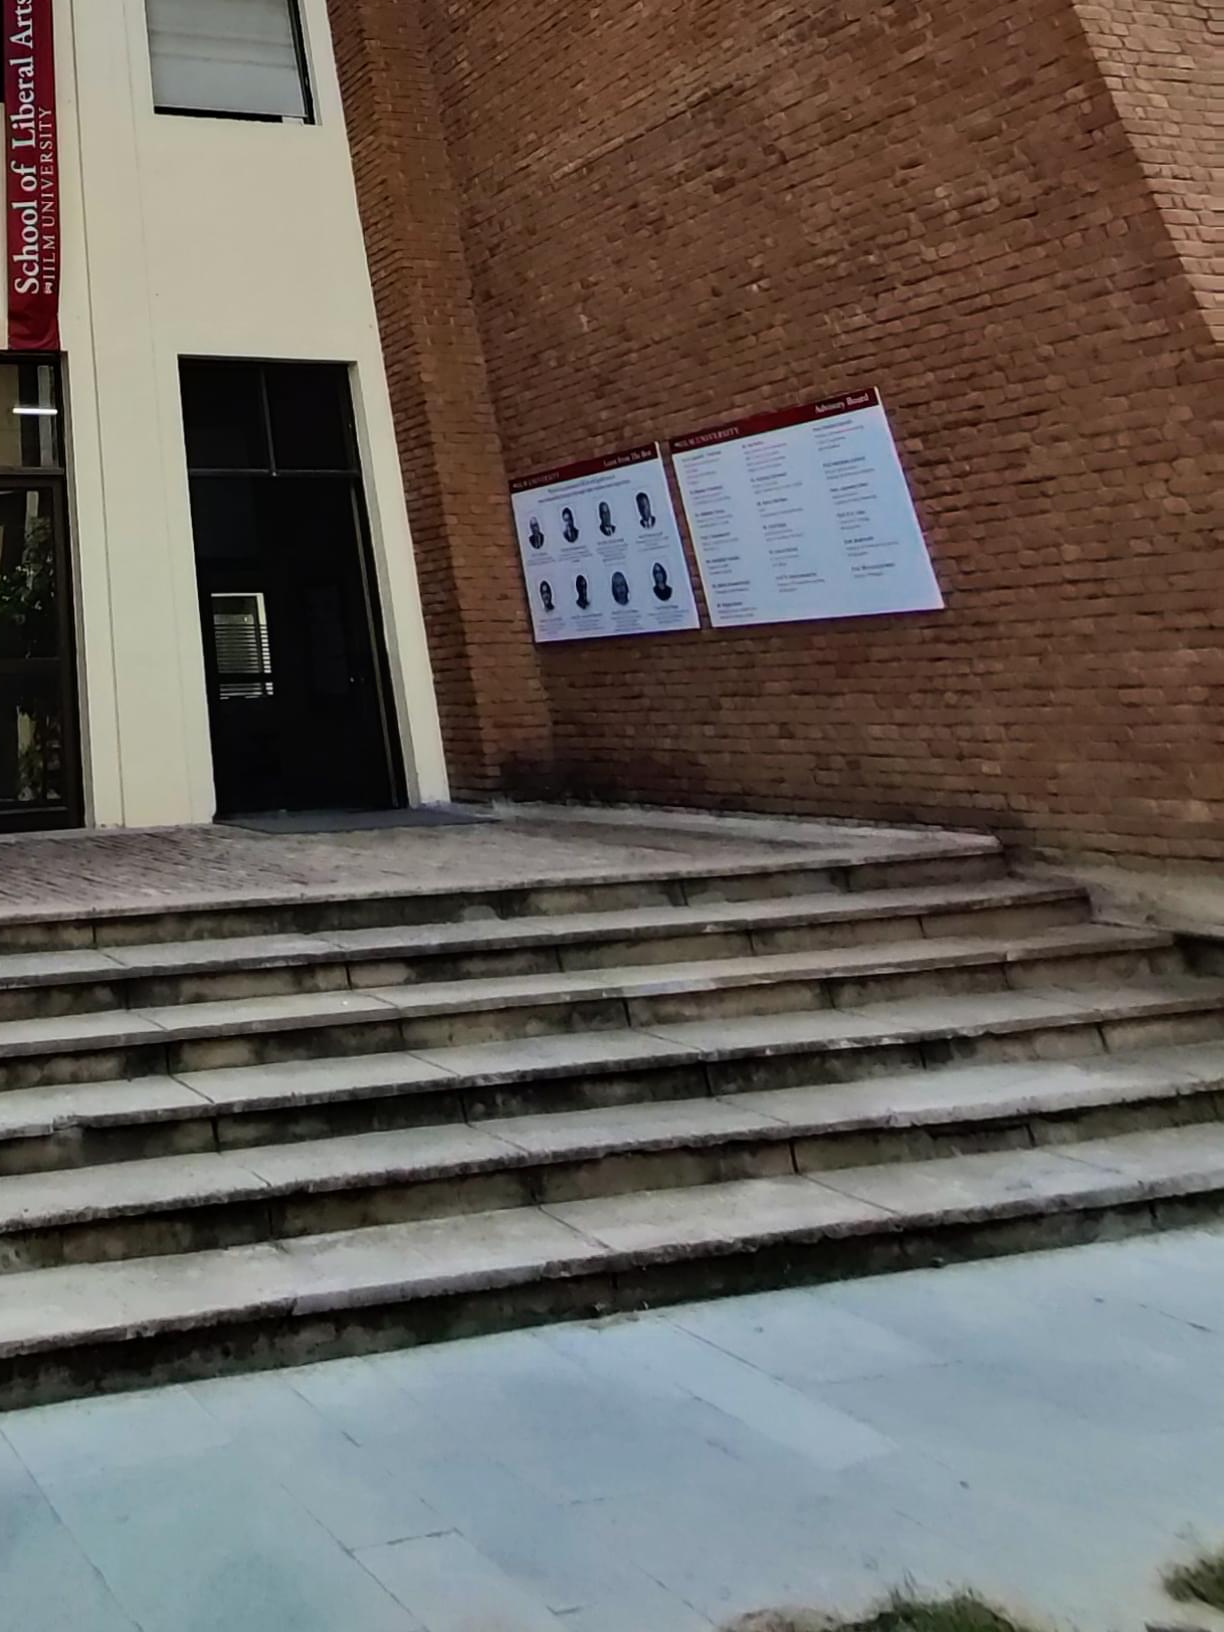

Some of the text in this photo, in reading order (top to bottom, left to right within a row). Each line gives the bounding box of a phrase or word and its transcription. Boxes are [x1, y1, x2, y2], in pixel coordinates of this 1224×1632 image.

[9, 55, 36, 150] Liberal
[10, 160, 38, 192] of
[38, 106, 56, 280] IILM UNIVERSITY
[11, 199, 40, 294] School
